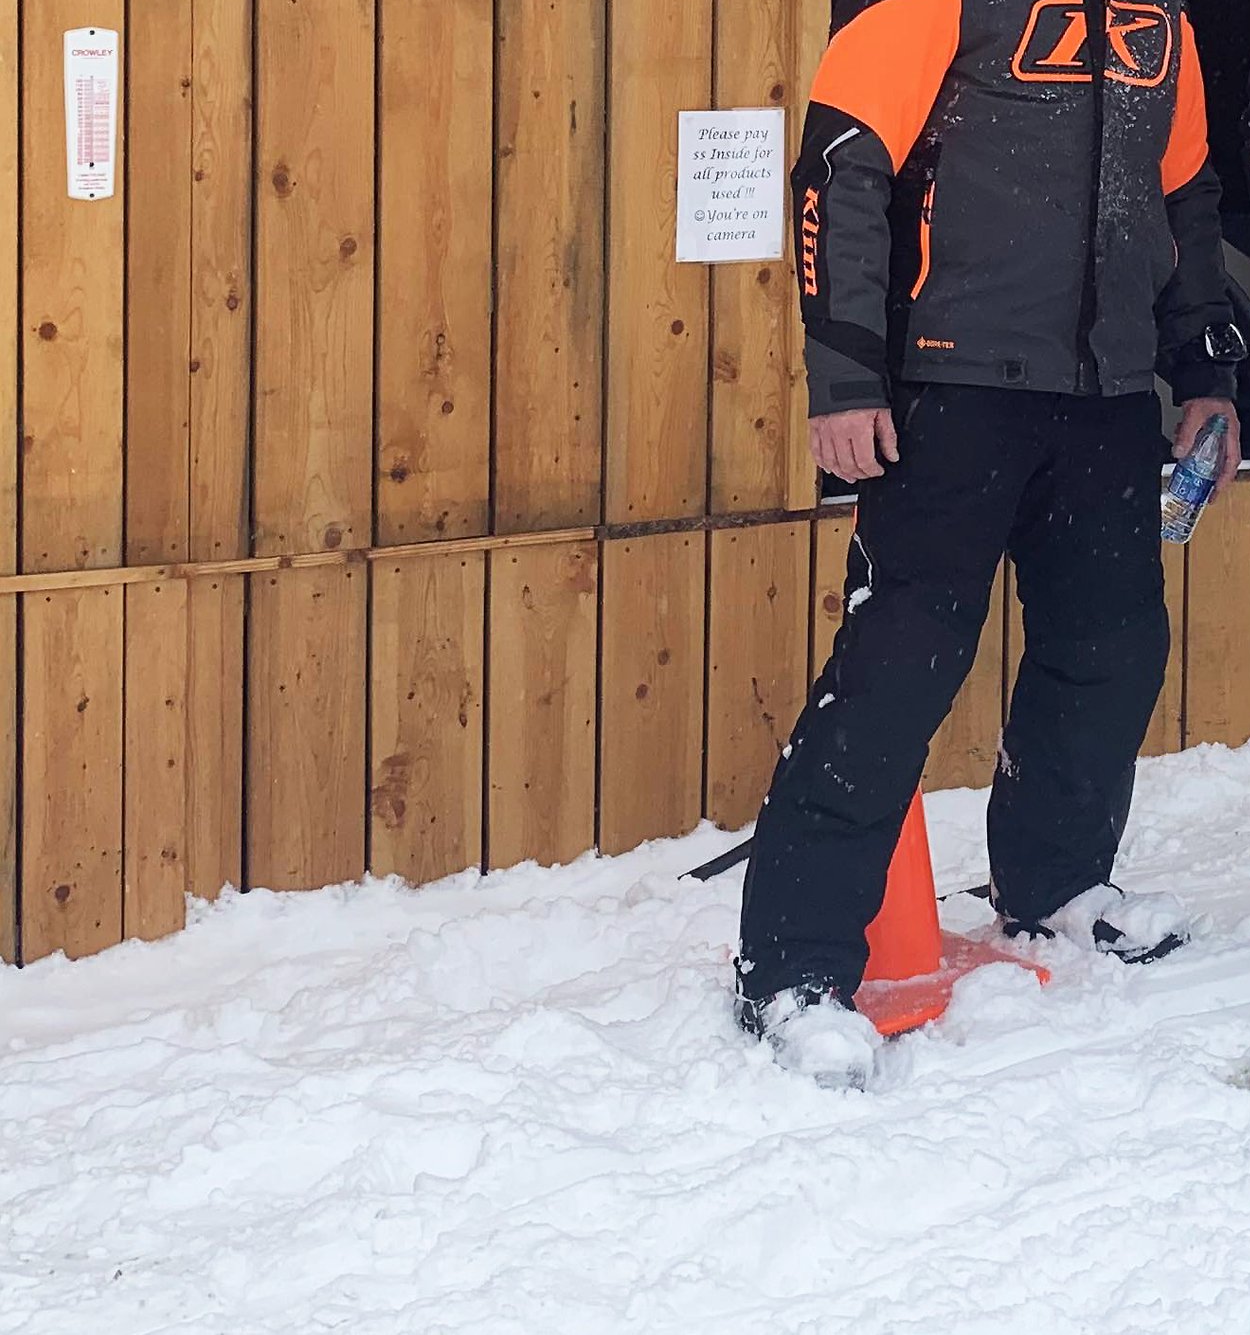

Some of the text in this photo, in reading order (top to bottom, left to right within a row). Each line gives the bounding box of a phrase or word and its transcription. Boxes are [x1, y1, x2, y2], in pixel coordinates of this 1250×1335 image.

[71, 49, 113, 57] CROWLEY
[699, 127, 769, 143] Please pay
[710, 146, 751, 160] Inside
[752, 145, 774, 164] for
[693, 167, 771, 184] all products
[711, 186, 745, 200] used
[707, 208, 768, 224] You're on
[706, 230, 756, 241] camera
